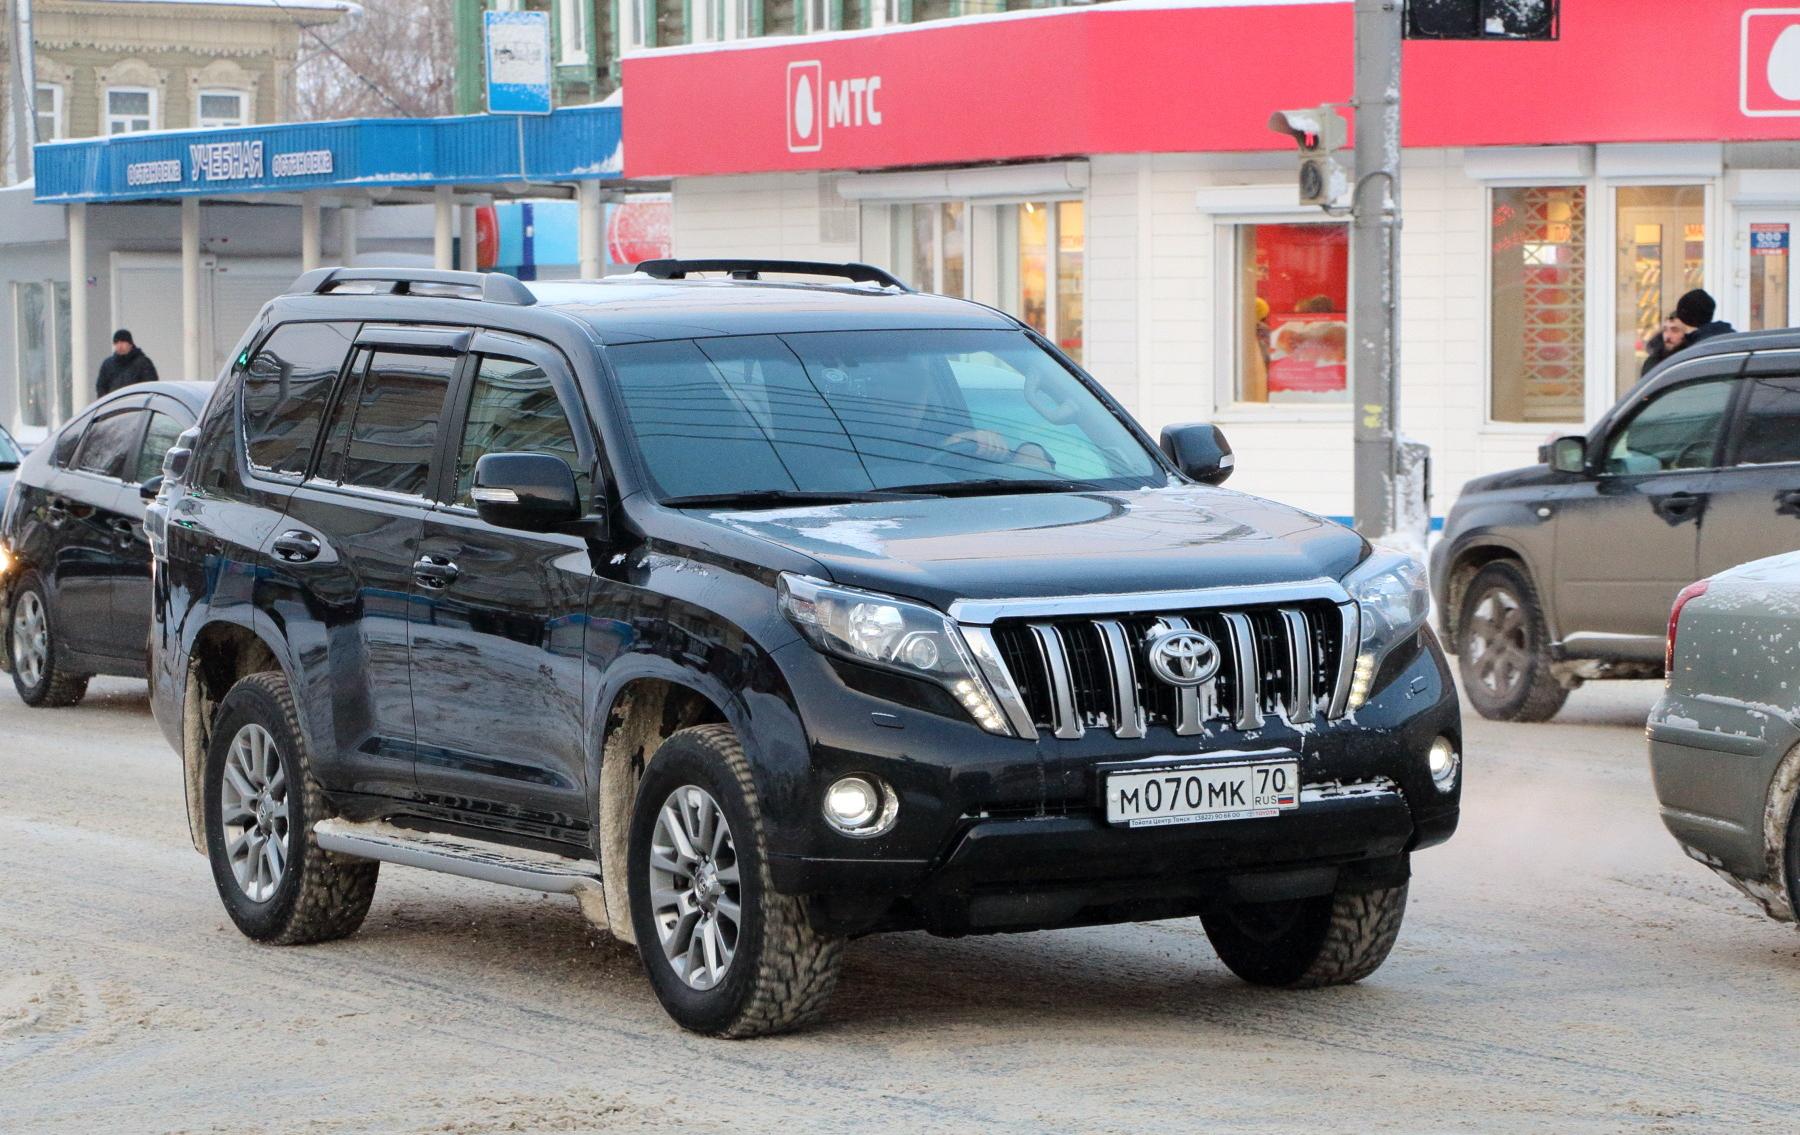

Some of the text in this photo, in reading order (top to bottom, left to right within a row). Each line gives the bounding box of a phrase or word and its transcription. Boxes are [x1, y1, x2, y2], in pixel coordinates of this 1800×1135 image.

[828, 76, 882, 128] МТС
[189, 140, 264, 181] УЧЕБНАЯ
[1256, 768, 1286, 794] 70
[1255, 795, 1277, 806] RUS
